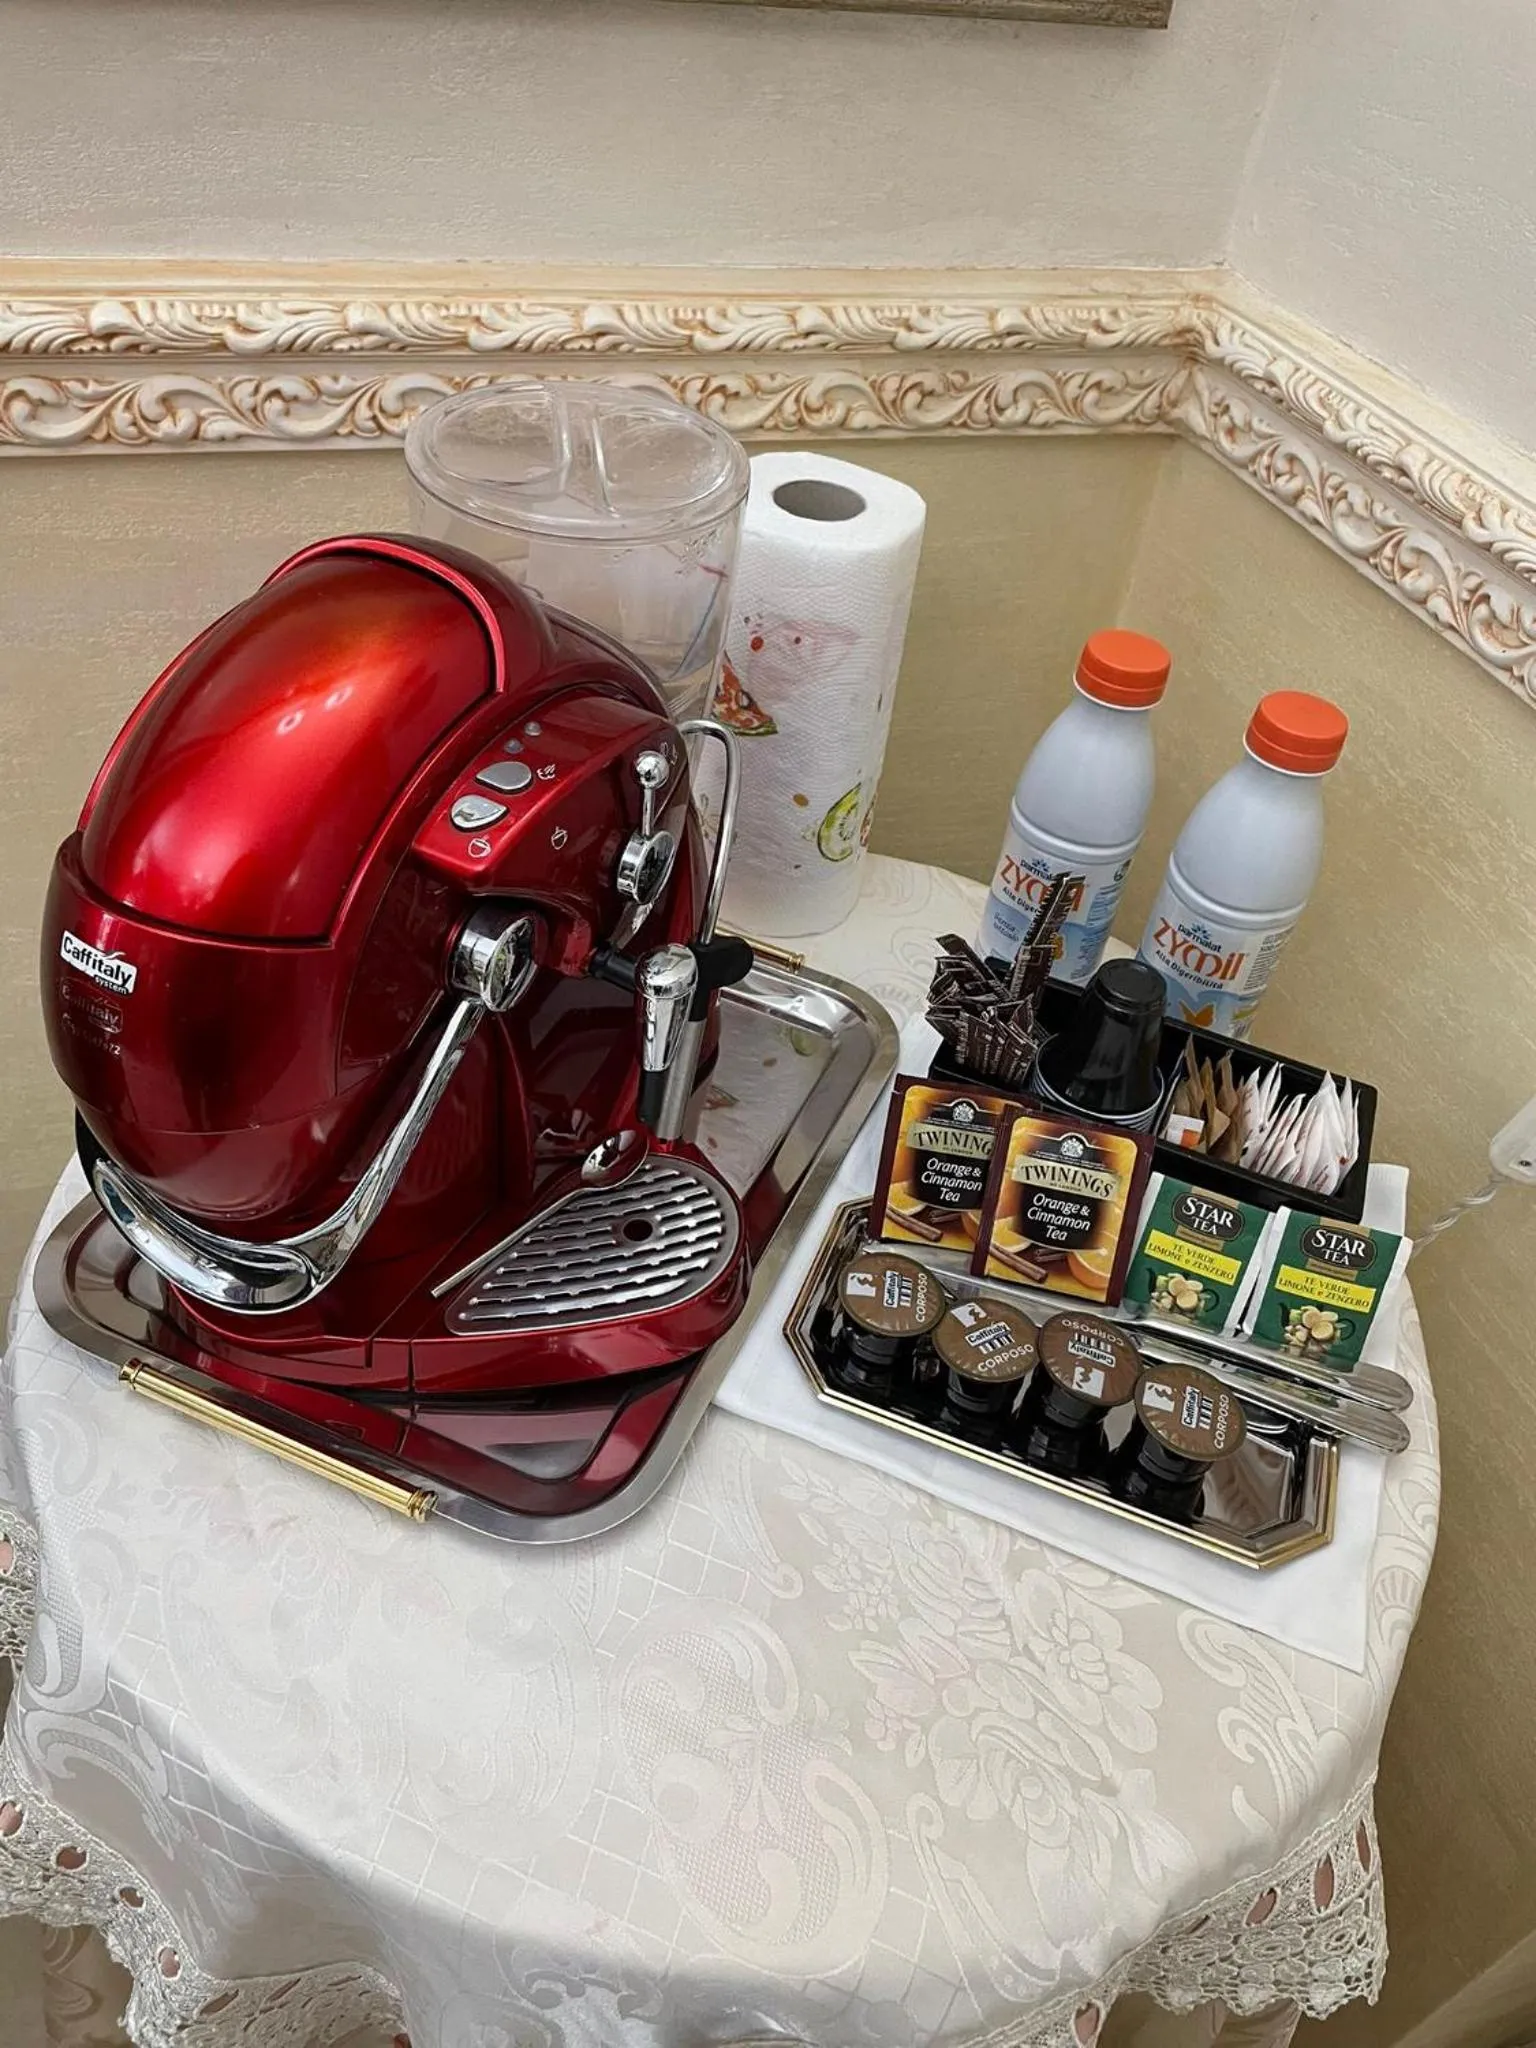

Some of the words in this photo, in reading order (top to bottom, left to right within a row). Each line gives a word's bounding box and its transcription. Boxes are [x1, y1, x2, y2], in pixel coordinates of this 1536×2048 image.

[63, 936, 132, 986] Caffitaly
[926, 1157, 973, 1177] Orange
[971, 1166, 982, 1178] &
[921, 1170, 982, 1192] Cinnamon
[1020, 1165, 1114, 1198] TWININGS
[939, 1187, 961, 1202] Tea
[1033, 1192, 1081, 1215] Orange
[1080, 1204, 1091, 1217] &
[1027, 1206, 1091, 1232] Cinnamon
[1181, 1196, 1235, 1230] STAR
[1191, 1215, 1218, 1236] TEA
[1046, 1224, 1069, 1242] Tea
[1311, 1228, 1366, 1258] STAR
[1321, 1248, 1350, 1267] TEA
[1192, 1260, 1235, 1281] ZENZERO
[915, 1272, 928, 1323] CORPOSO
[1325, 1291, 1371, 1309] ZENZERO
[967, 1323, 1008, 1344] Caffitaly
[1061, 1318, 1125, 1347] CORPOSO
[977, 1343, 1034, 1373] CORPOSO
[1213, 1393, 1230, 1450] CORPOSO
